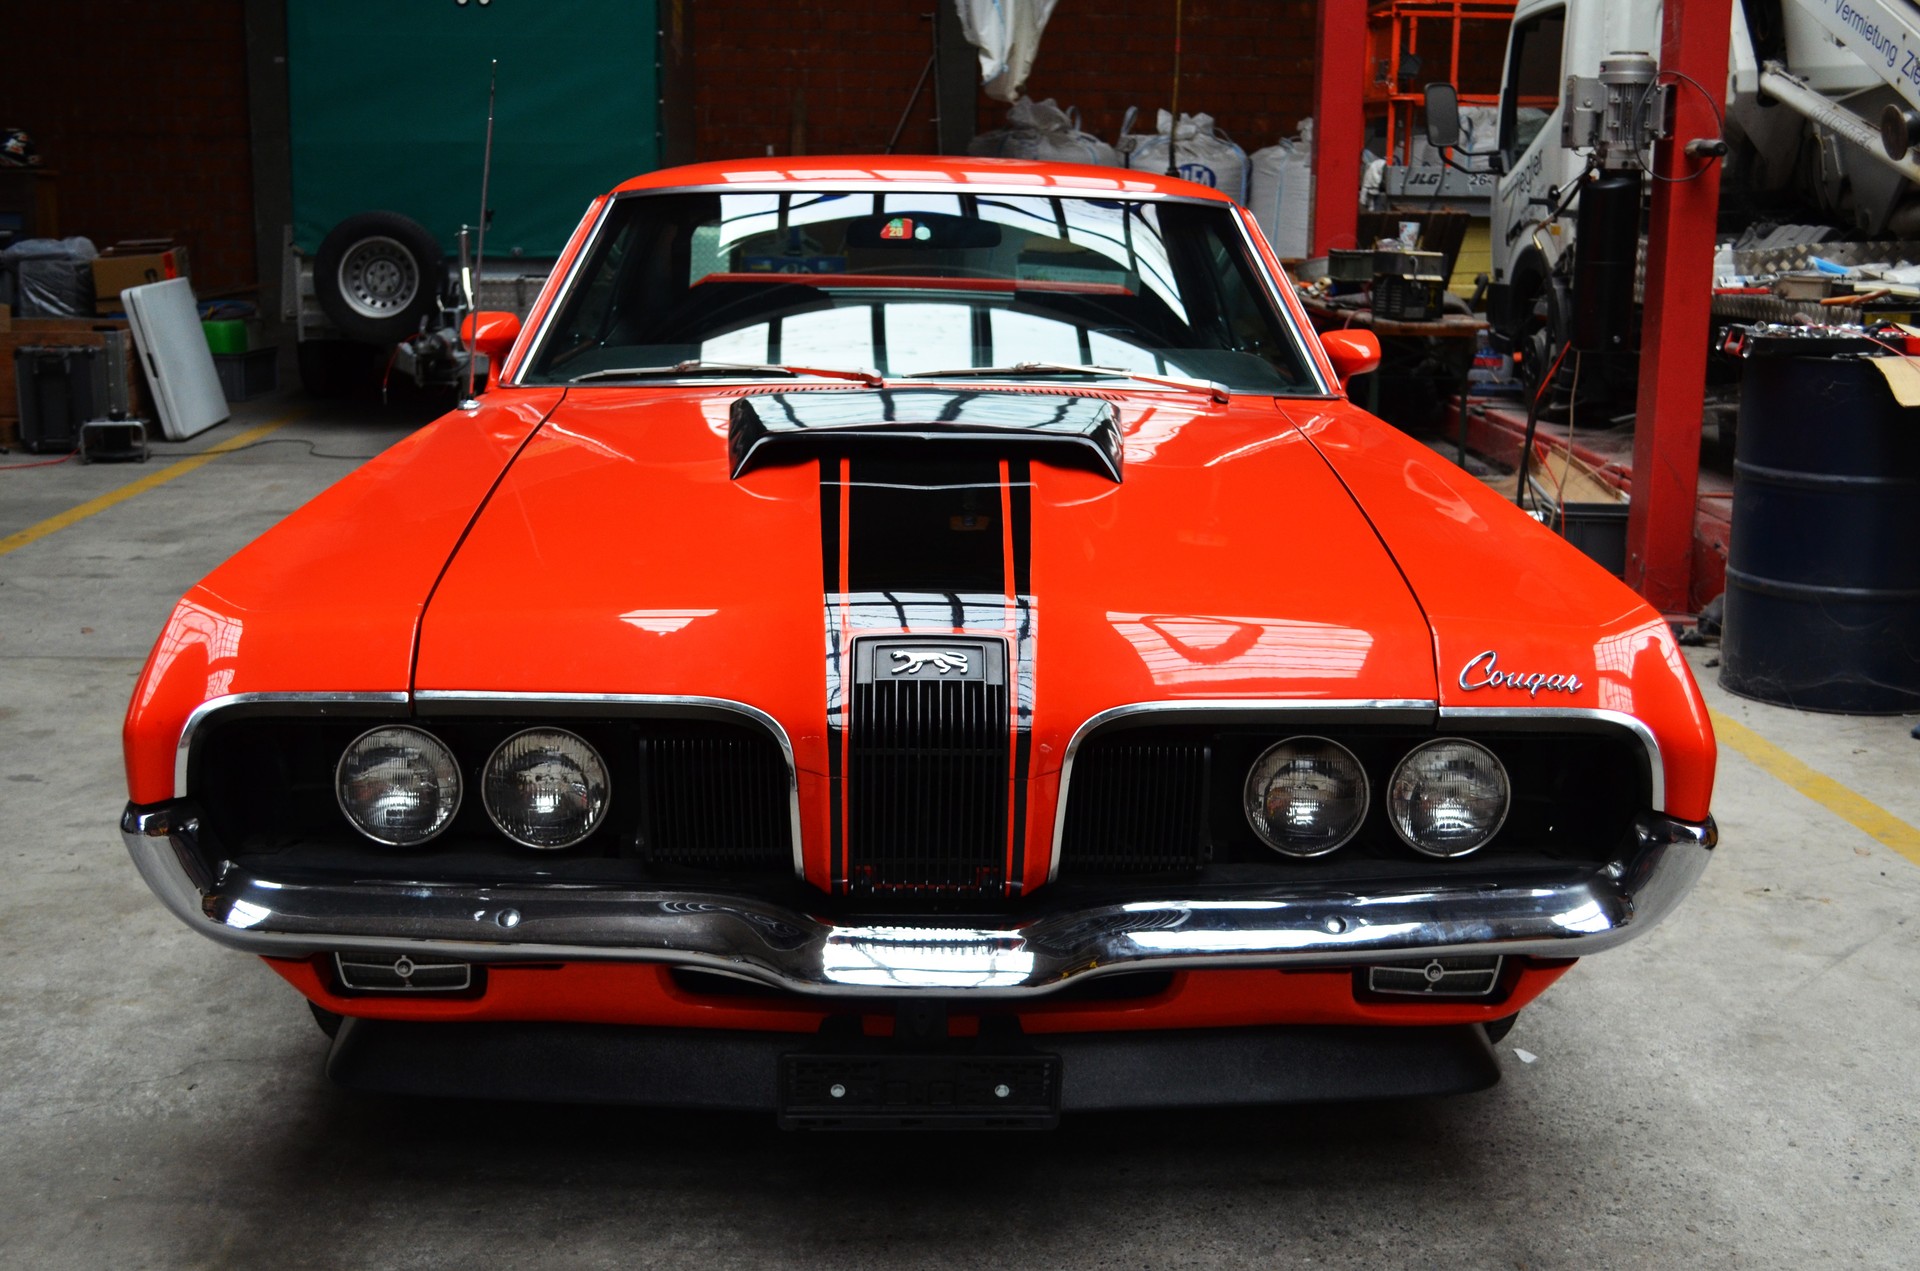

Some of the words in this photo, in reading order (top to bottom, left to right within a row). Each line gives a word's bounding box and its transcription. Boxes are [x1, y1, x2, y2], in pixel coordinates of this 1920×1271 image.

[1834, 0, 1898, 68] Vermietung
[1408, 172, 1440, 185] JLG
[1458, 650, 1583, 698] Cougar
